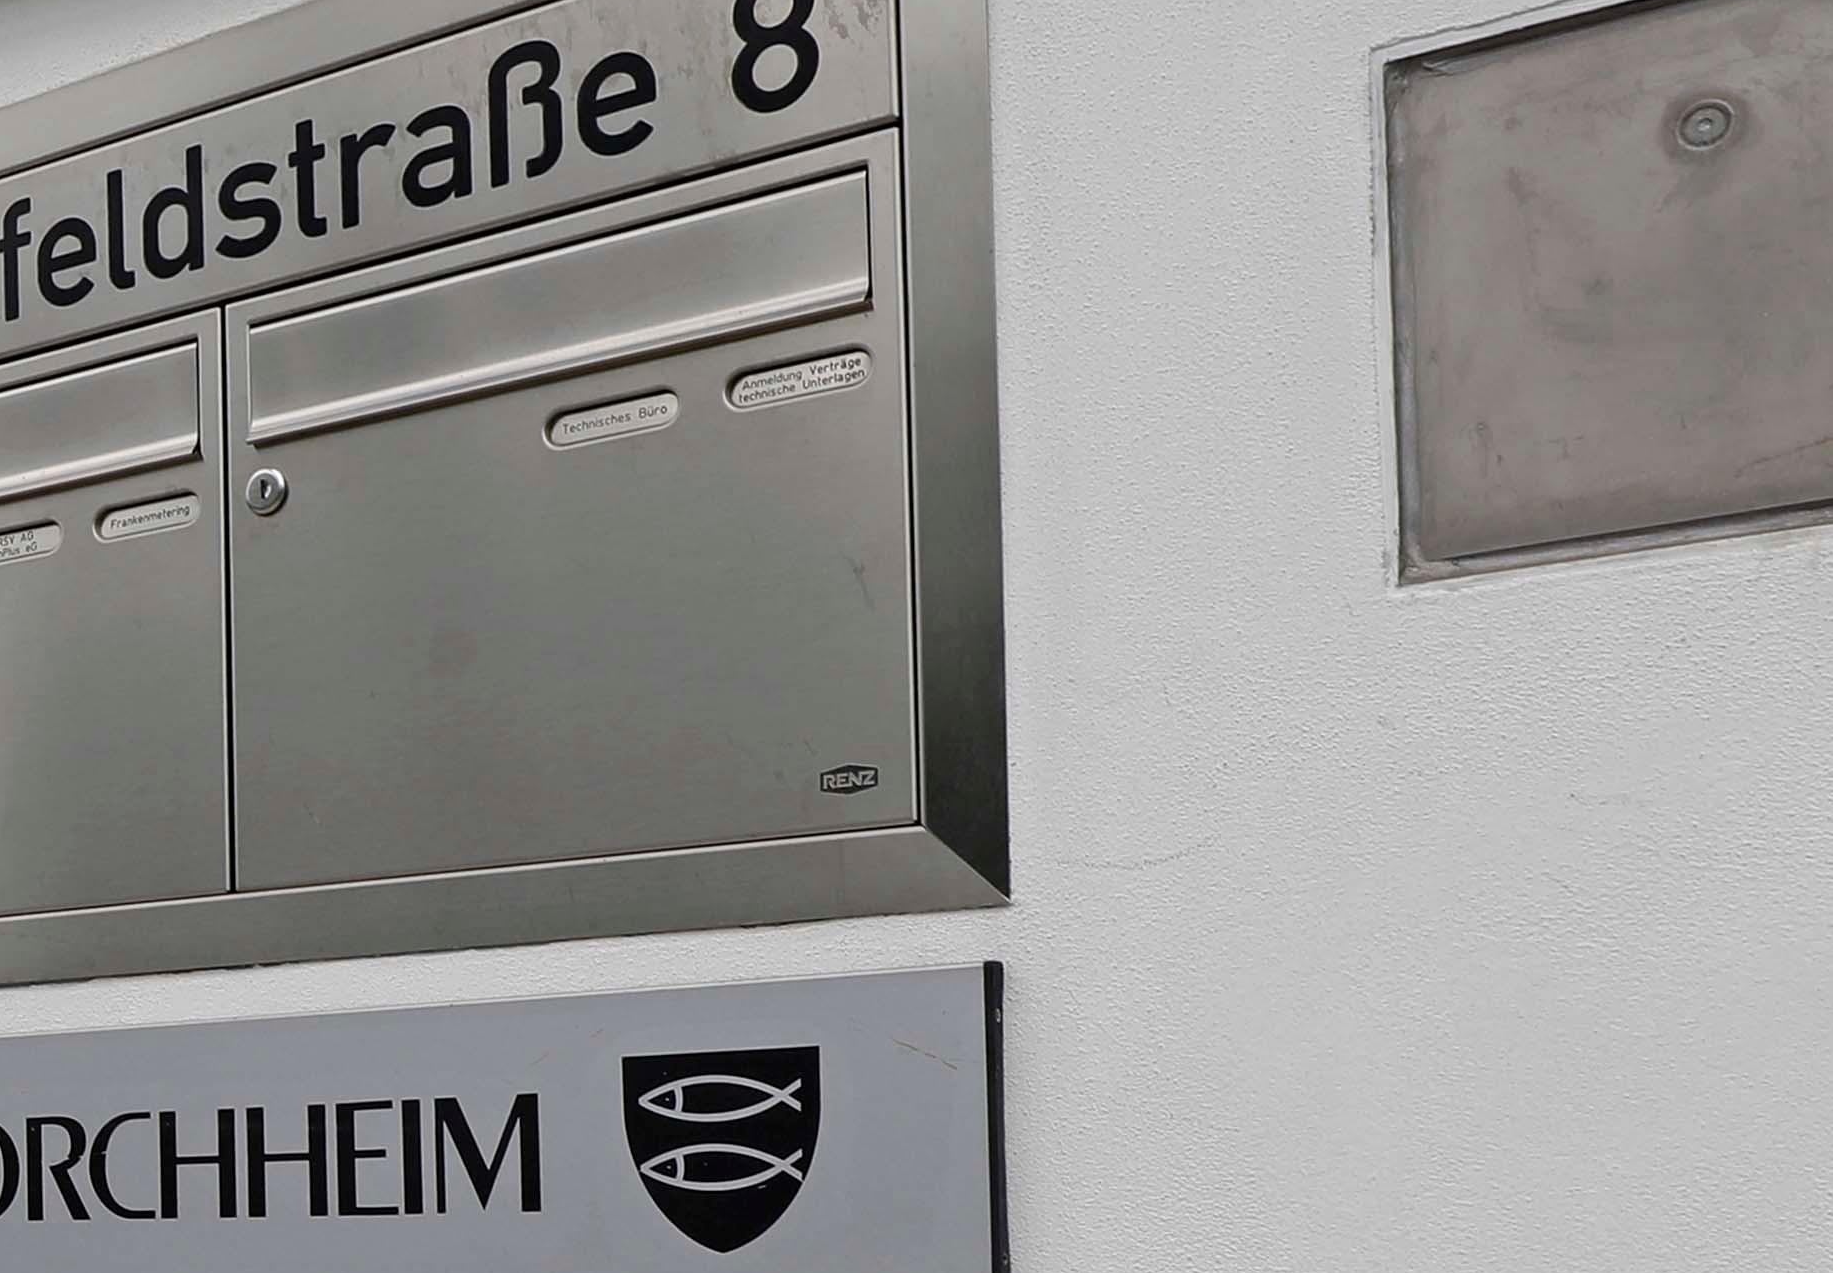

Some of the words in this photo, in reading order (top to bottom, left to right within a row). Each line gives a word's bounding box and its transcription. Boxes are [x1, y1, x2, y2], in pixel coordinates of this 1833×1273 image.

[738, 383, 796, 404] technische
[802, 368, 865, 390] Unterlagen
[742, 368, 802, 391] Anmeldung
[810, 357, 862, 378] Verträge
[562, 411, 631, 435] Technisches
[639, 404, 668, 420] Büro
[110, 504, 191, 530] Frankenmetering
[21, 531, 34, 542] AG
[25, 541, 38, 553] eG
[822, 769, 876, 790] RENZ
